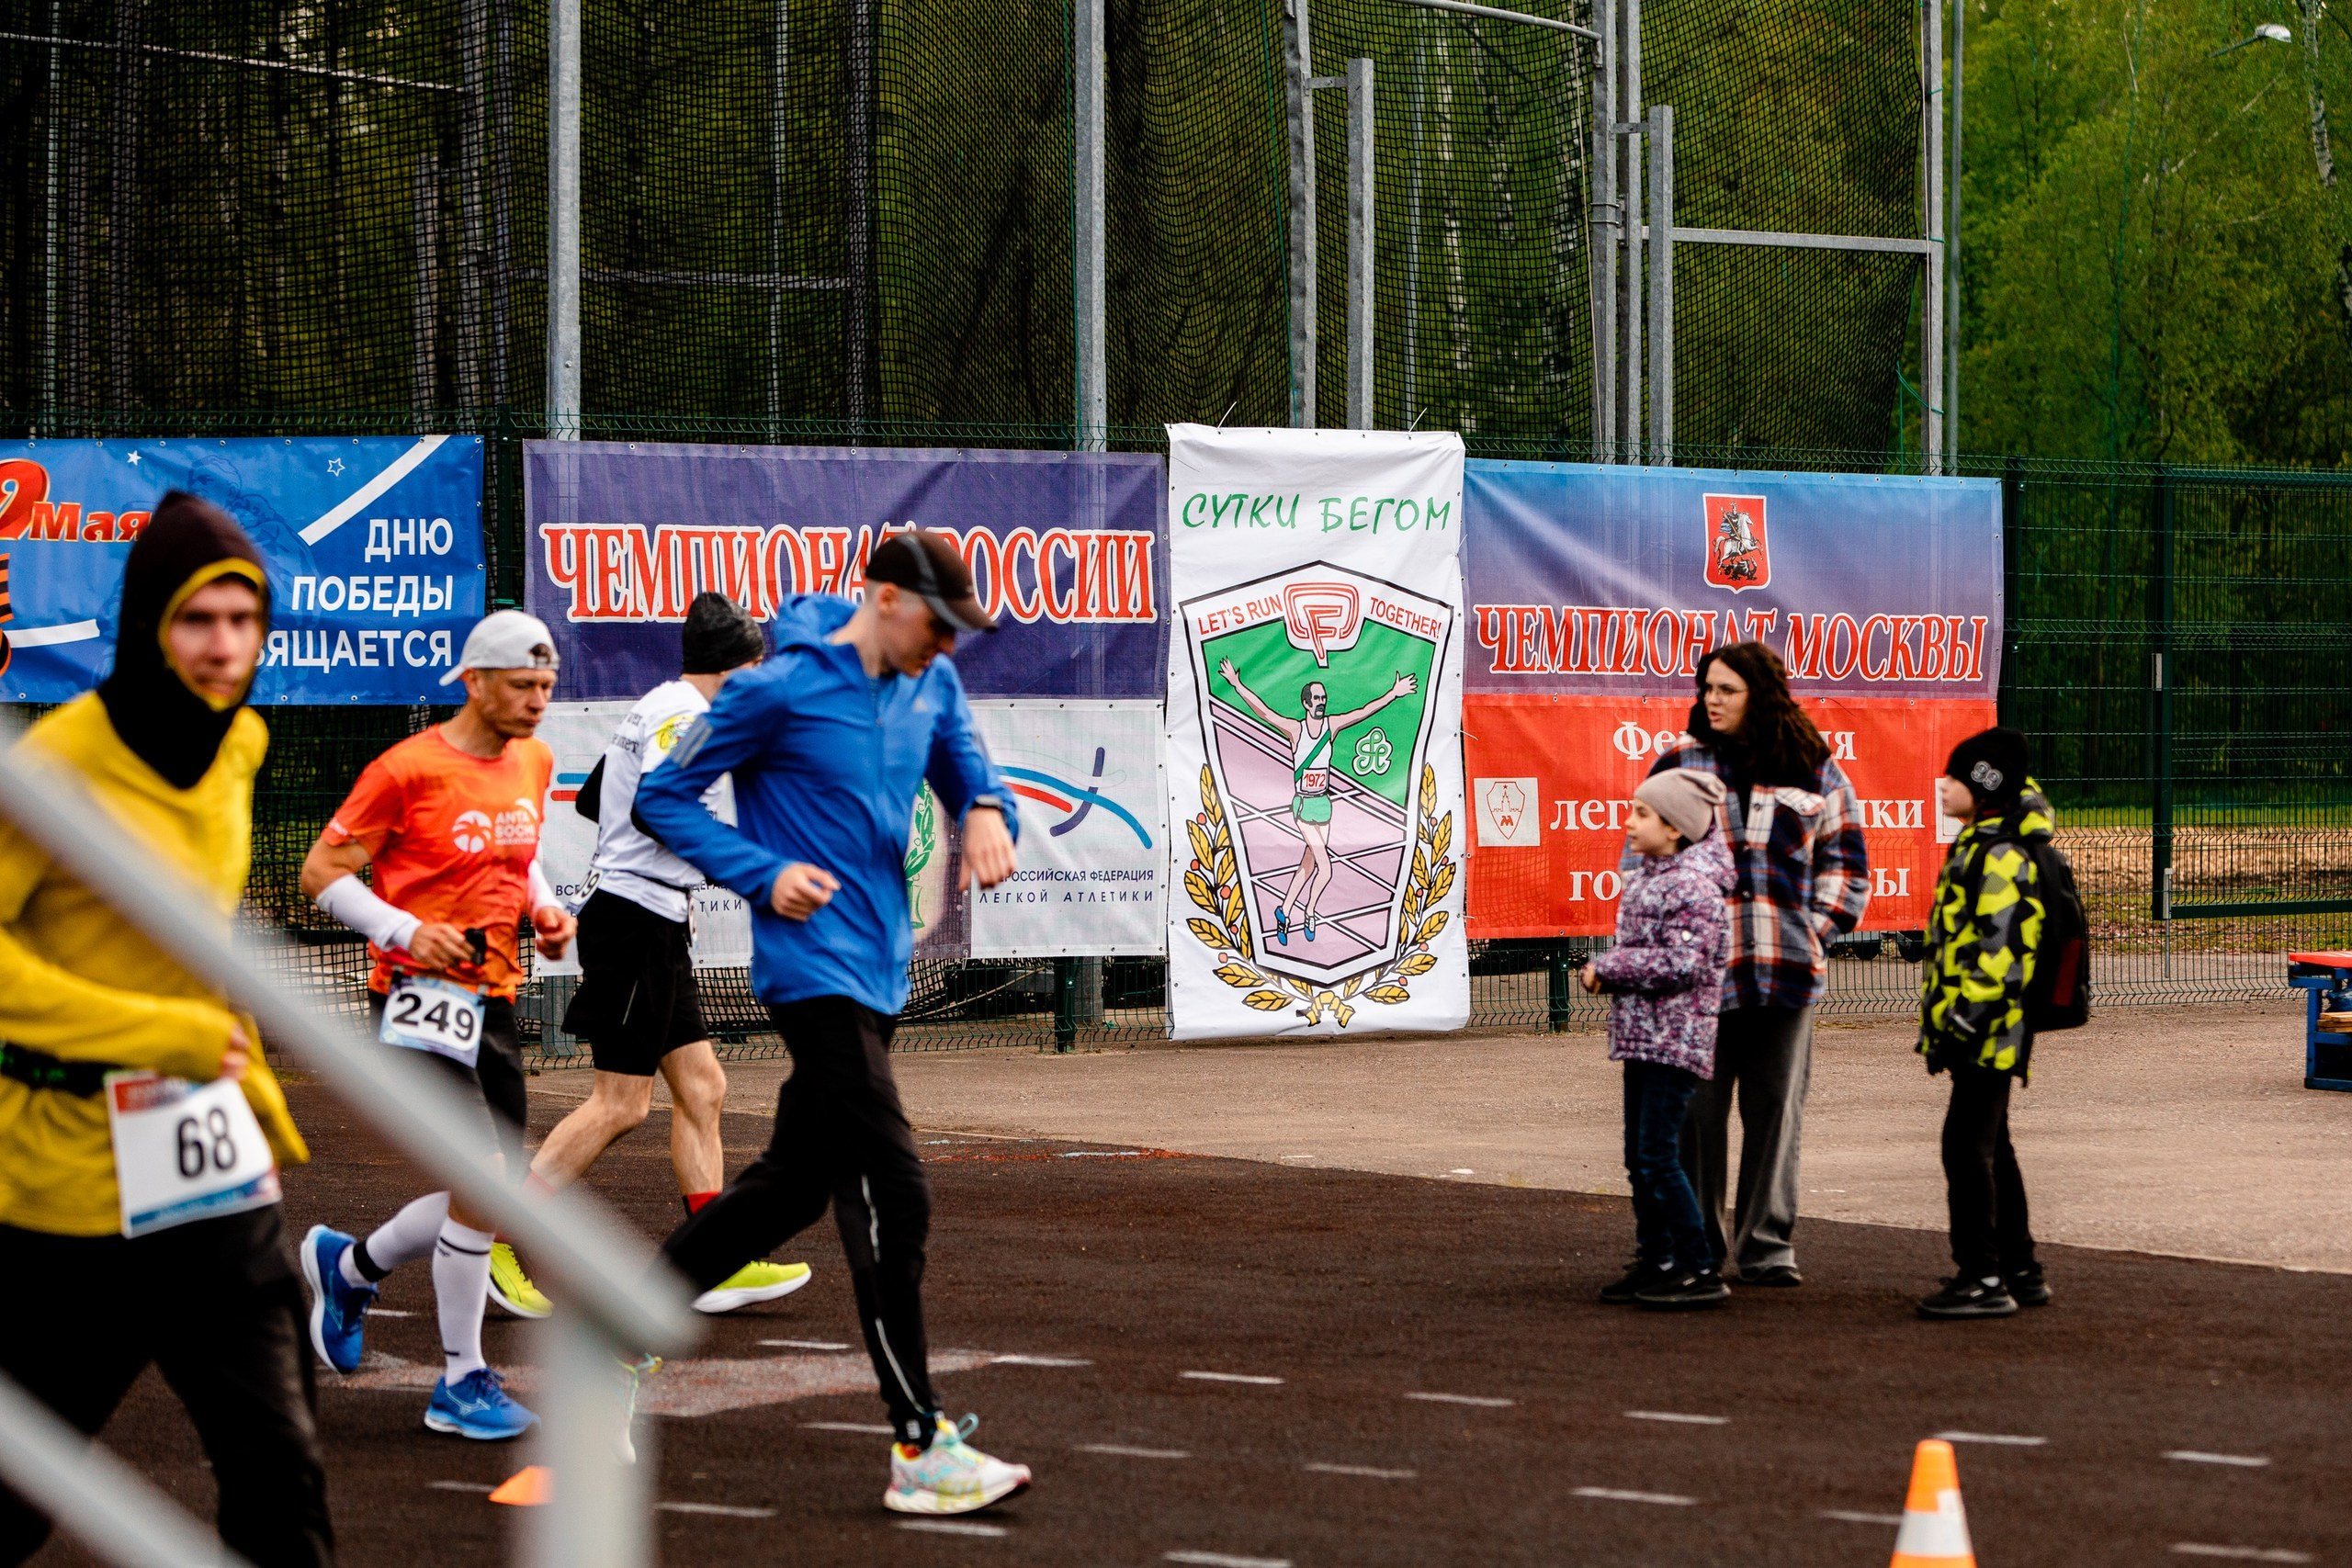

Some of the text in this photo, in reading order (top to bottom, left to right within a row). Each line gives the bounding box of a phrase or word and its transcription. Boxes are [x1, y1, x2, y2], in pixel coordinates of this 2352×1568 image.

[28, 502, 152, 543] Мая
[1182, 492, 1451, 535] СУТКИ БЕГОМ
[364, 517, 454, 563] ДНЮ
[291, 575, 453, 618] ПОБЕДЫ
[1197, 593, 1442, 639] LET'S RUN TOGETHER!
[1785, 612, 1988, 682] МОСКВЫ
[1304, 773, 1327, 787] 1972
[979, 889, 1153, 904] ЛЕГКОЙ АТЛЕТИКИ
[1090, 869, 1154, 883] ФЕДЕРАЦИЯ
[392, 992, 475, 1041] 249
[176, 1105, 237, 1179] 68
